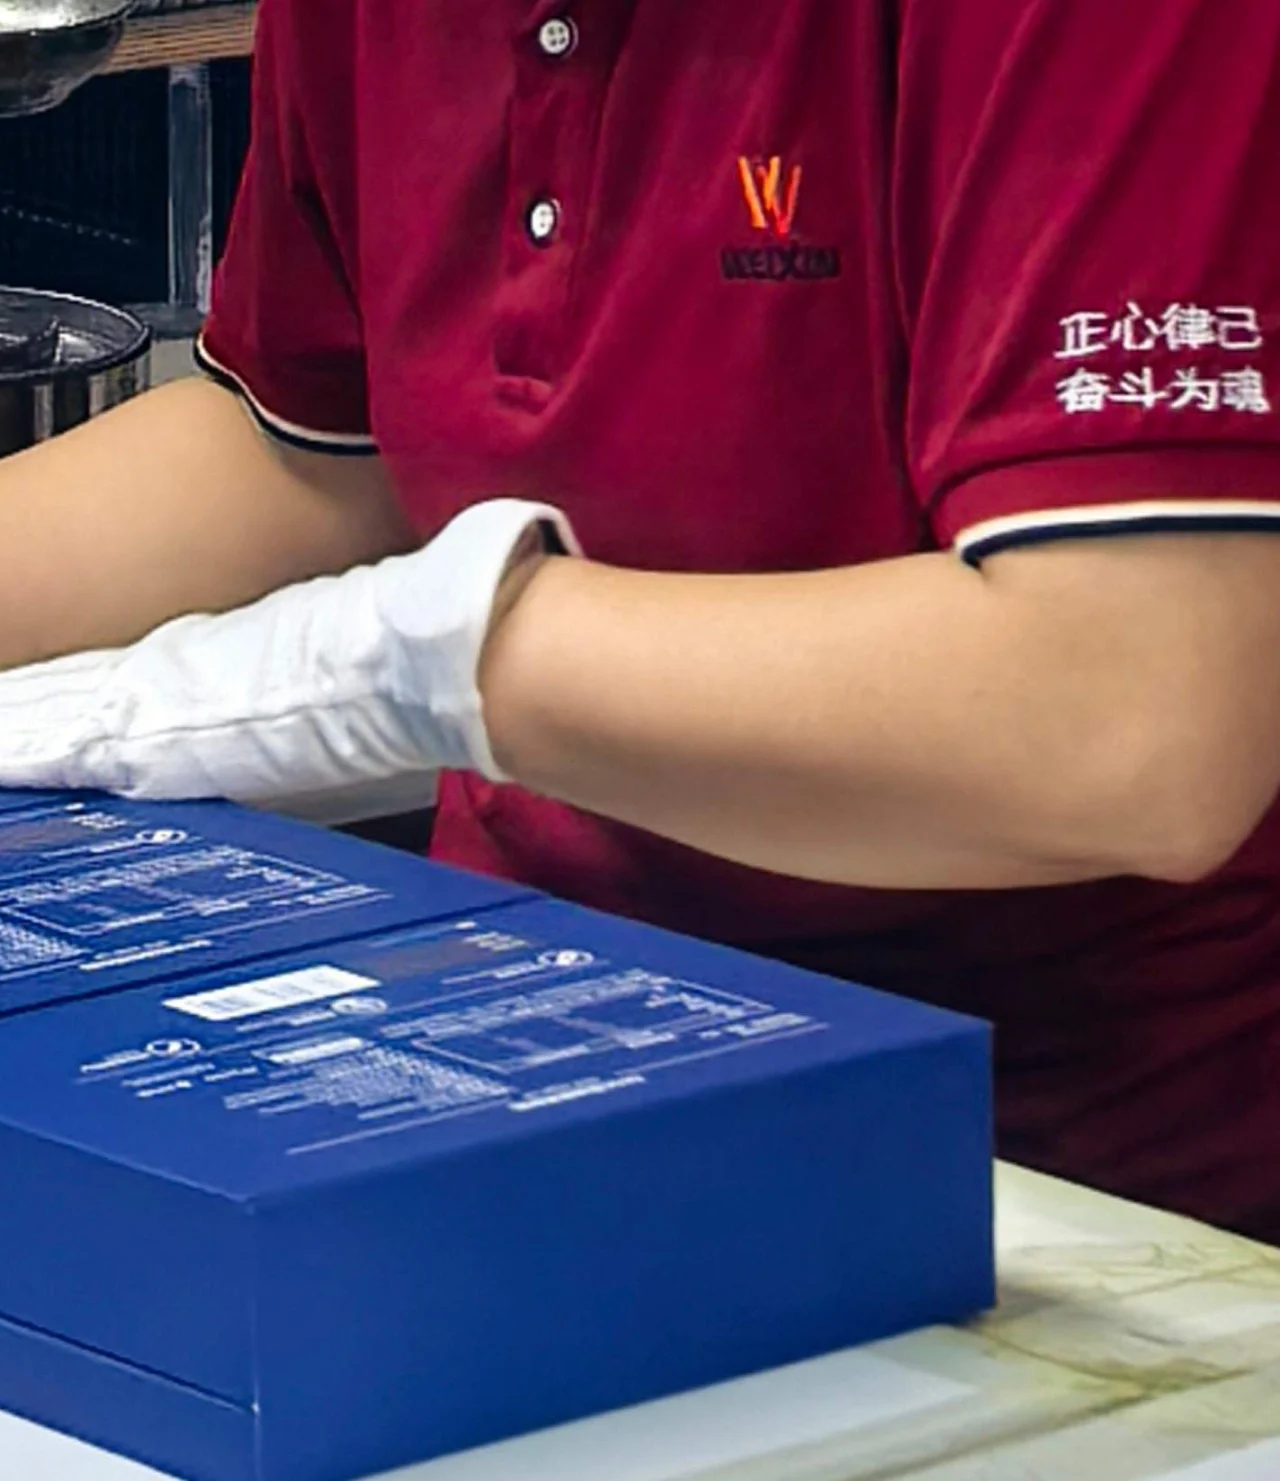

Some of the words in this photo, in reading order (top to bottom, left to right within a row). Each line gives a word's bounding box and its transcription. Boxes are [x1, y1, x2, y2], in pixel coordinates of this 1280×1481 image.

[1053, 299, 1263, 359] 正心律己
[1056, 364, 1272, 415] 奋斗为魂
